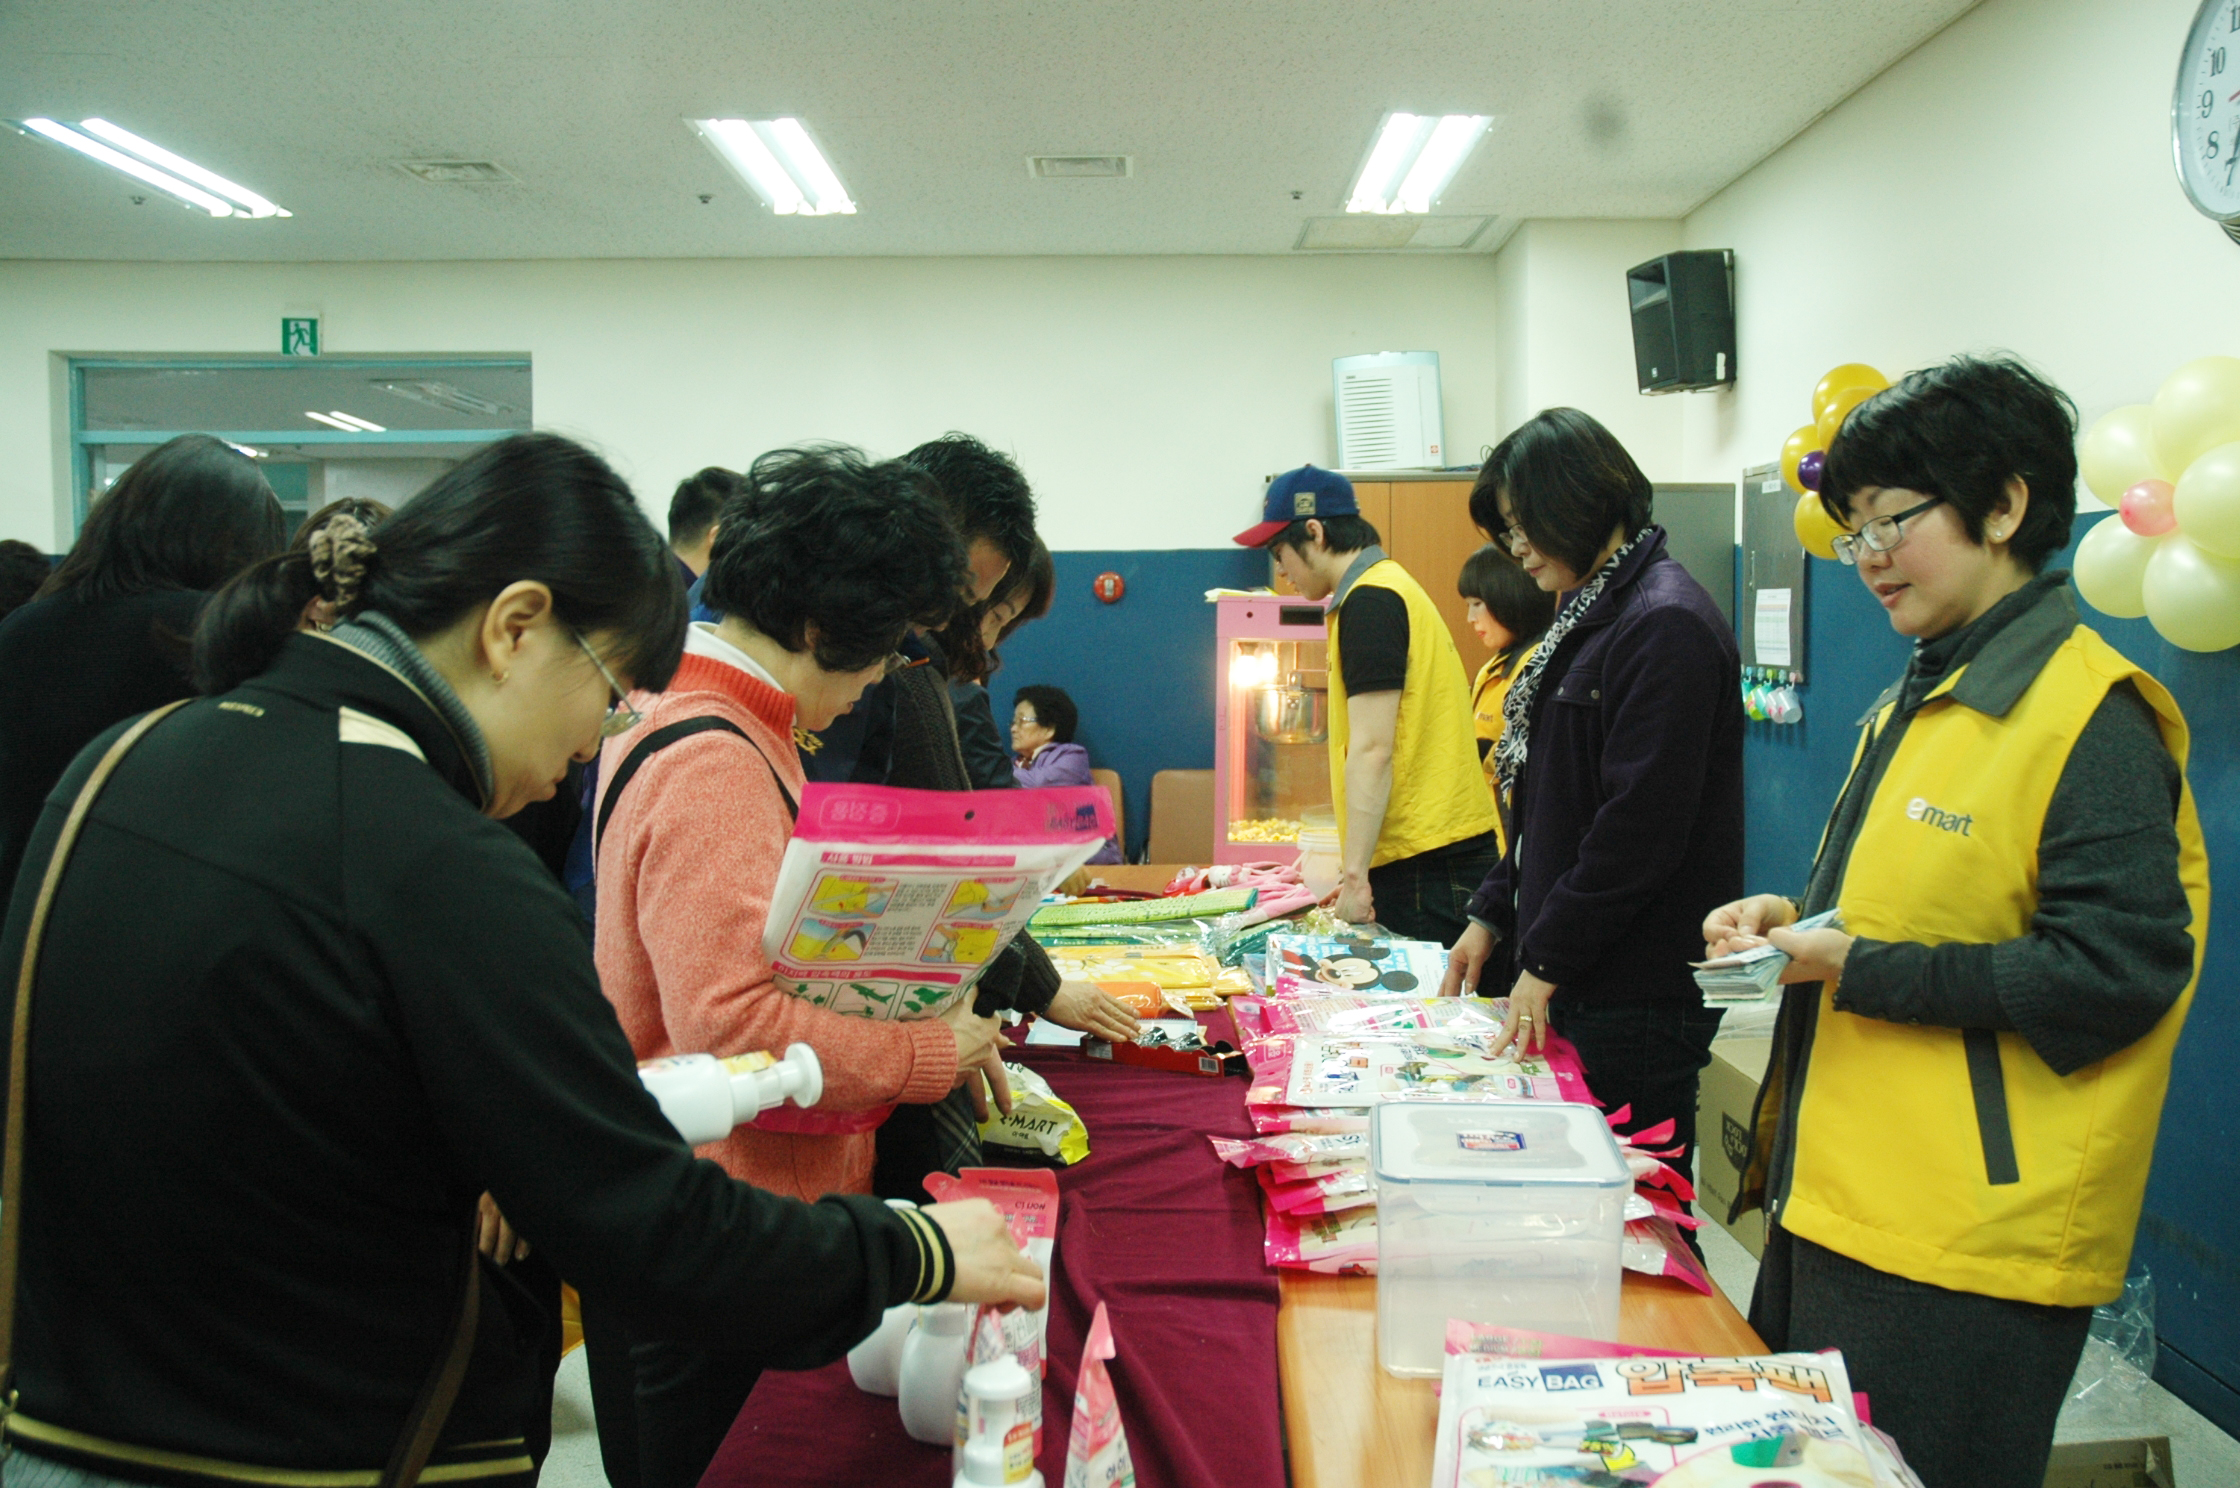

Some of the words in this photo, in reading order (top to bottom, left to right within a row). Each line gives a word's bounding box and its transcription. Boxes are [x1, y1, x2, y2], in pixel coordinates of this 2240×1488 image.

[2210, 47, 2226, 77] 10
[2201, 89, 2214, 119] 9
[2206, 130, 2219, 159] 8
[1907, 797, 1973, 837] emart
[1478, 1374, 1539, 1389] EASY
[1545, 1374, 1600, 1390] BAG
